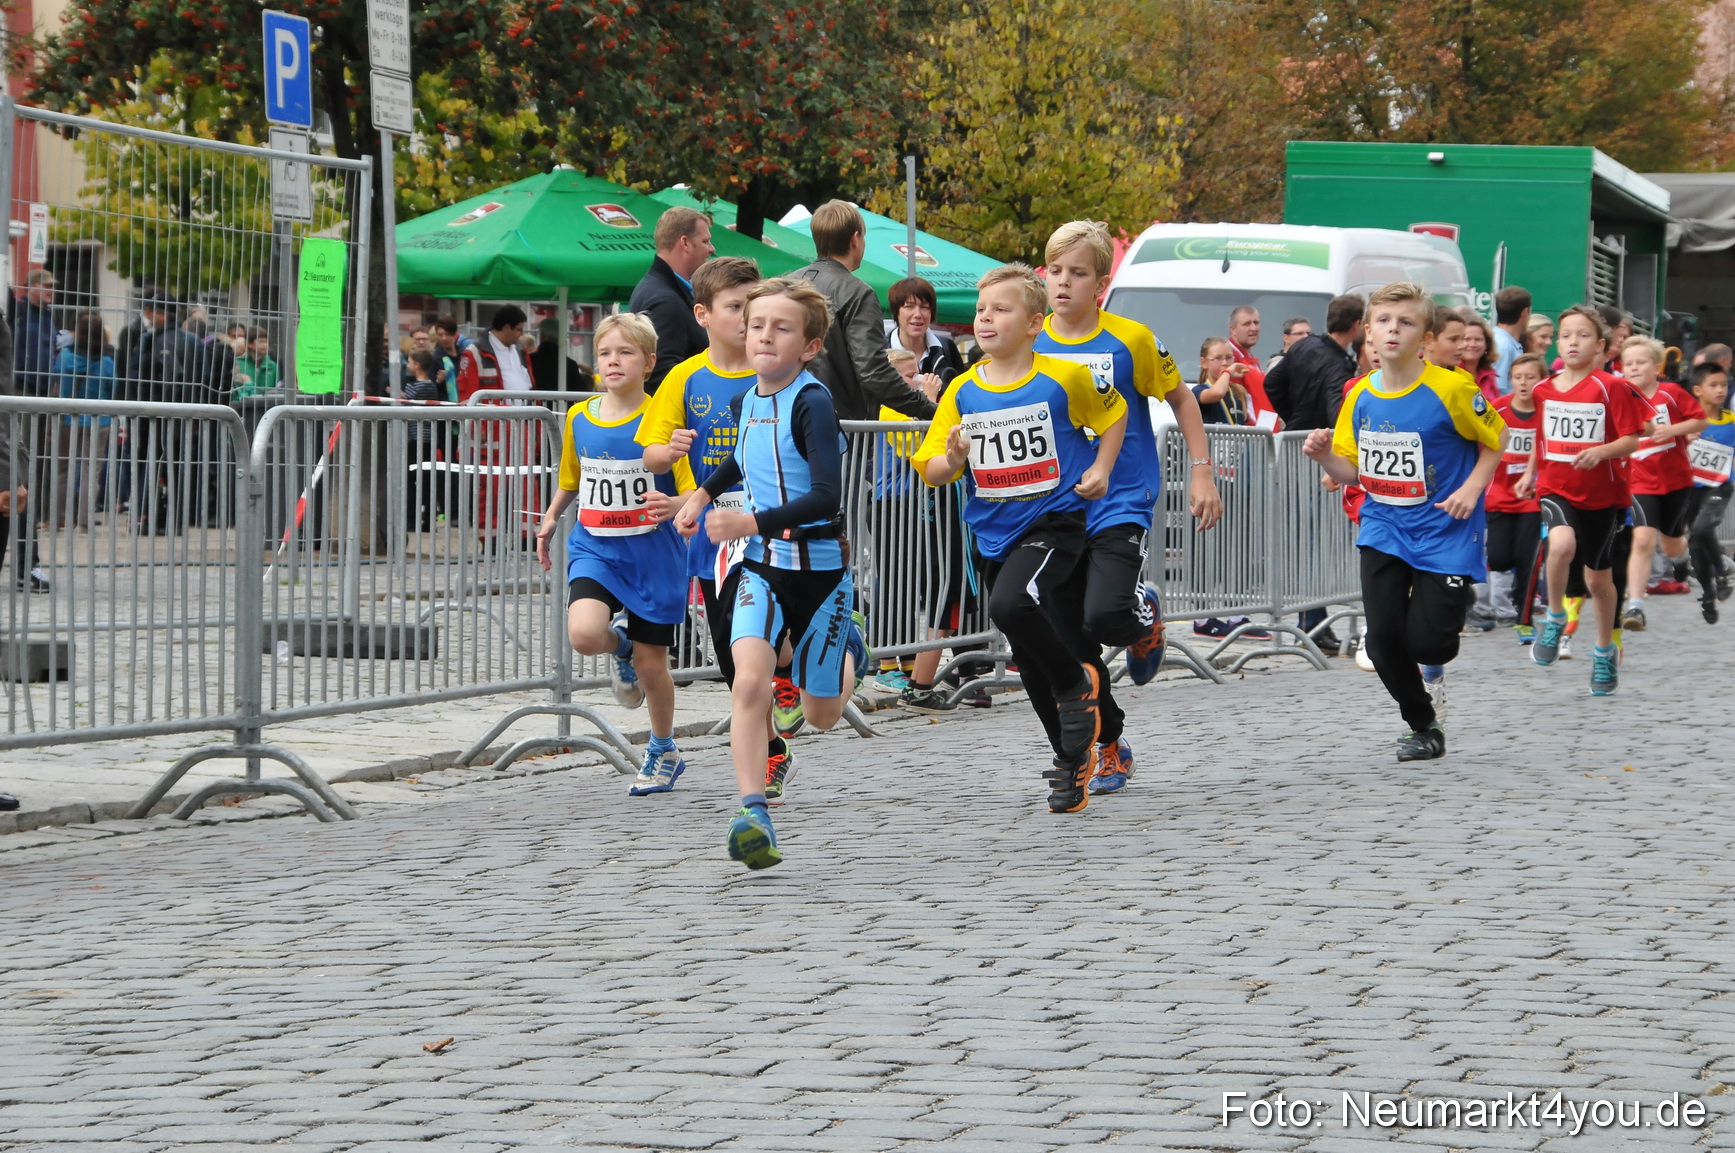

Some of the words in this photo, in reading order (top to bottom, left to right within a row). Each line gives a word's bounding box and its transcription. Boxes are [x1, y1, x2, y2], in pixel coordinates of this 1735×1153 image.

[275, 28, 300, 108] P
[1226, 239, 1288, 249] Europcar
[1250, 249, 1270, 257] your
[961, 421, 988, 431] PARTL
[989, 414, 1035, 428] Neumarkt
[1550, 416, 1599, 439] 7037
[970, 426, 1047, 464] 7195
[1509, 435, 1532, 451] 06
[1361, 446, 1416, 477] 7225
[1692, 448, 1728, 471] 7547
[582, 465, 600, 475] PARTL
[602, 467, 640, 475] Neumarkt
[986, 468, 1042, 486] Benjamin
[586, 477, 648, 506] 7019
[1371, 481, 1406, 495] Michael
[716, 499, 743, 509] PARTL
[600, 514, 631, 526] Jakob
